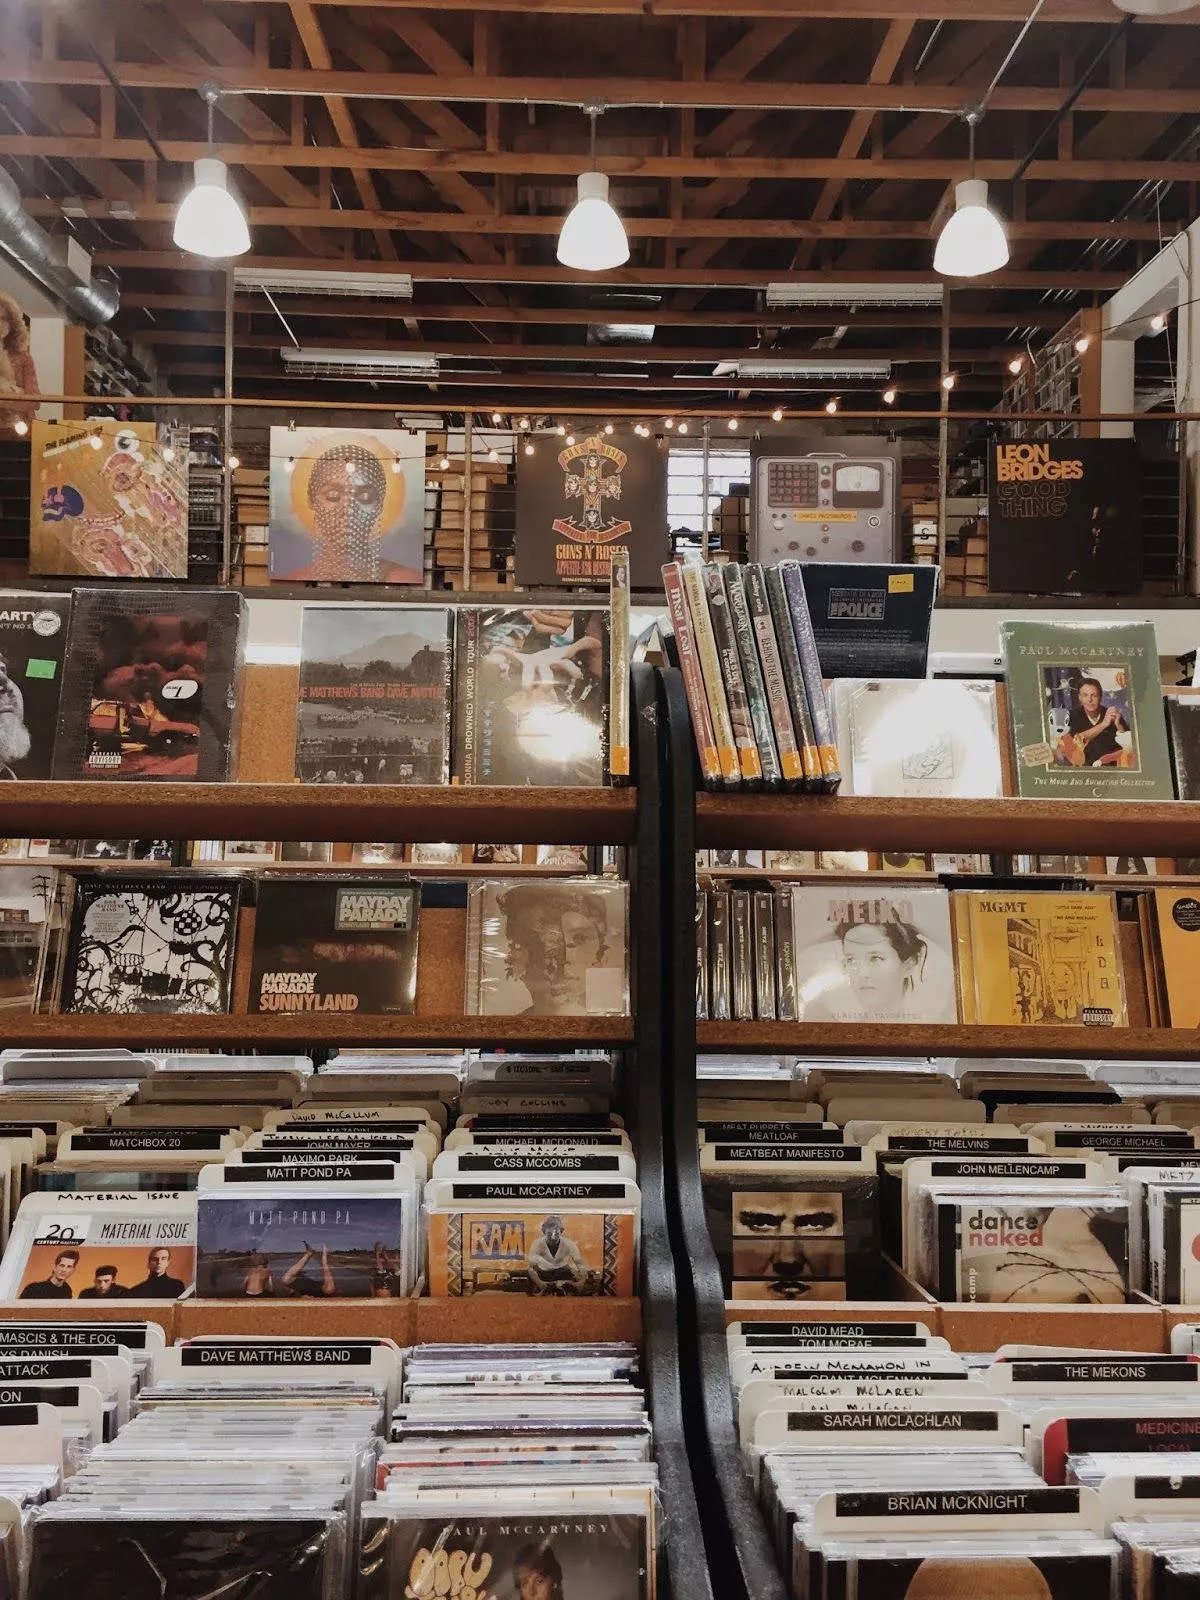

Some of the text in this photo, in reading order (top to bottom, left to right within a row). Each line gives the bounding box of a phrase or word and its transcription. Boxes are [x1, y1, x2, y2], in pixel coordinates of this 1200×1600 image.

[997, 443, 1049, 463] LEON
[997, 460, 1084, 481] BRIDGES
[998, 480, 1071, 499] GOOD
[998, 498, 1068, 517] THING
[555, 545, 583, 559] GUNS
[838, 602, 883, 617] POLICE
[467, 639, 475, 664] TOUR
[1019, 645, 1054, 656] PAUL
[762, 637, 774, 665] BEHIND
[768, 664, 778, 681] THE
[466, 667, 475, 701] WORLD
[310, 687, 359, 698] MATTHEWS
[361, 687, 385, 698] BAND
[465, 703, 473, 750] DROWNED
[89, 756, 121, 764] ADVISORY
[341, 895, 411, 909] MAYDAY
[979, 901, 1027, 913] MGMT
[340, 908, 407, 922] PARADE
[262, 973, 317, 983] MAYDAY
[261, 983, 315, 994] PARADE
[260, 994, 358, 1011] SUNNYLAND
[750, 1132, 799, 1140] MEATLOAF
[109, 1138, 181, 1147] MATCHBOX 20
[927, 1139, 989, 1149] THE MELVINS
[1082, 1138, 1165, 1147] GEORGE MICHAEL
[282, 1154, 358, 1163] MAXIMO PARK
[731, 1149, 845, 1158] MEATBEAT MANIFESTO
[494, 1158, 581, 1168] CASS MCCOMBS
[267, 1168, 351, 1178] MATT POND PA
[957, 1164, 1060, 1175] JOHN MELLENCAMP
[58, 1192, 180, 1201] MATERIAL ISSUE
[486, 1186, 592, 1196] PAUL MCCARTNEY
[293, 1211, 326, 1225] POND
[335, 1211, 350, 1225] PA
[969, 1210, 1038, 1230] dance
[101, 1223, 190, 1238] MATERIAL ISSUE
[969, 1224, 1043, 1246] naked
[472, 1223, 525, 1257] RAM
[792, 1326, 863, 1336] DAVID MEAD
[0, 1333, 116, 1344] MASCIS & THE FOG
[201, 1350, 350, 1361] DAVE MATTHEWS BAND
[916, 1360, 931, 1368] IN
[0, 1364, 49, 1376] ATTACK
[1065, 1367, 1146, 1378] THE MEKONS
[0, 1391, 21, 1402] ON
[823, 1415, 962, 1427] SARAH MCLACHLAN
[1135, 1422, 1200, 1434] MEDICINE
[888, 1495, 1028, 1510] BRIAN MCKNIGHT
[442, 1525, 488, 1536] PAUL
